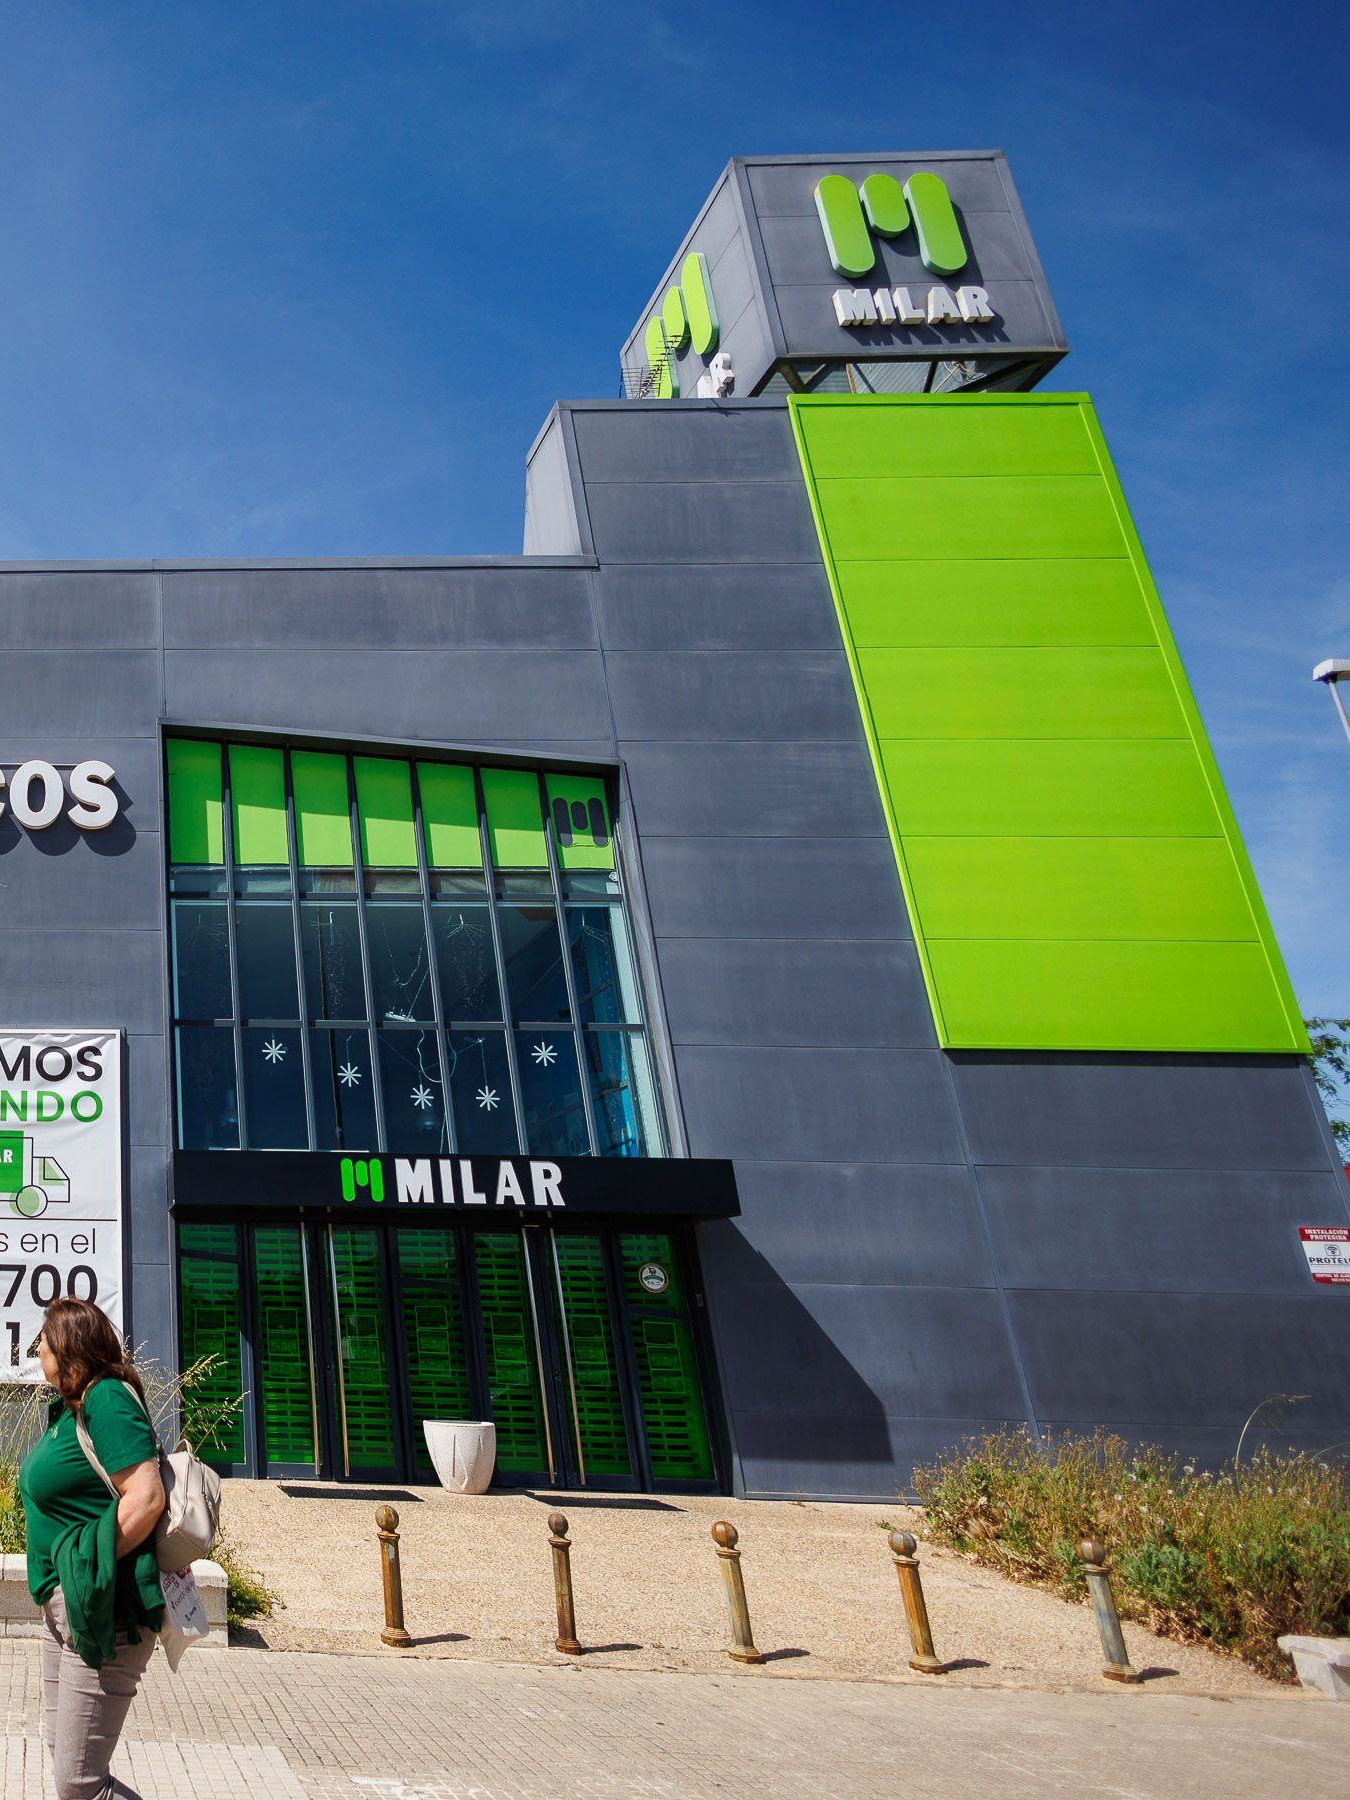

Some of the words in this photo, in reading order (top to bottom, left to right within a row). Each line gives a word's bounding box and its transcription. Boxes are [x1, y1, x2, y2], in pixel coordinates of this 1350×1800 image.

[832, 285, 994, 327] MILAR
[394, 1158, 565, 1206] MILAR
[20, 1233, 59, 1253] en
[71, 1228, 96, 1254] el
[0, 1264, 98, 1308] 700
